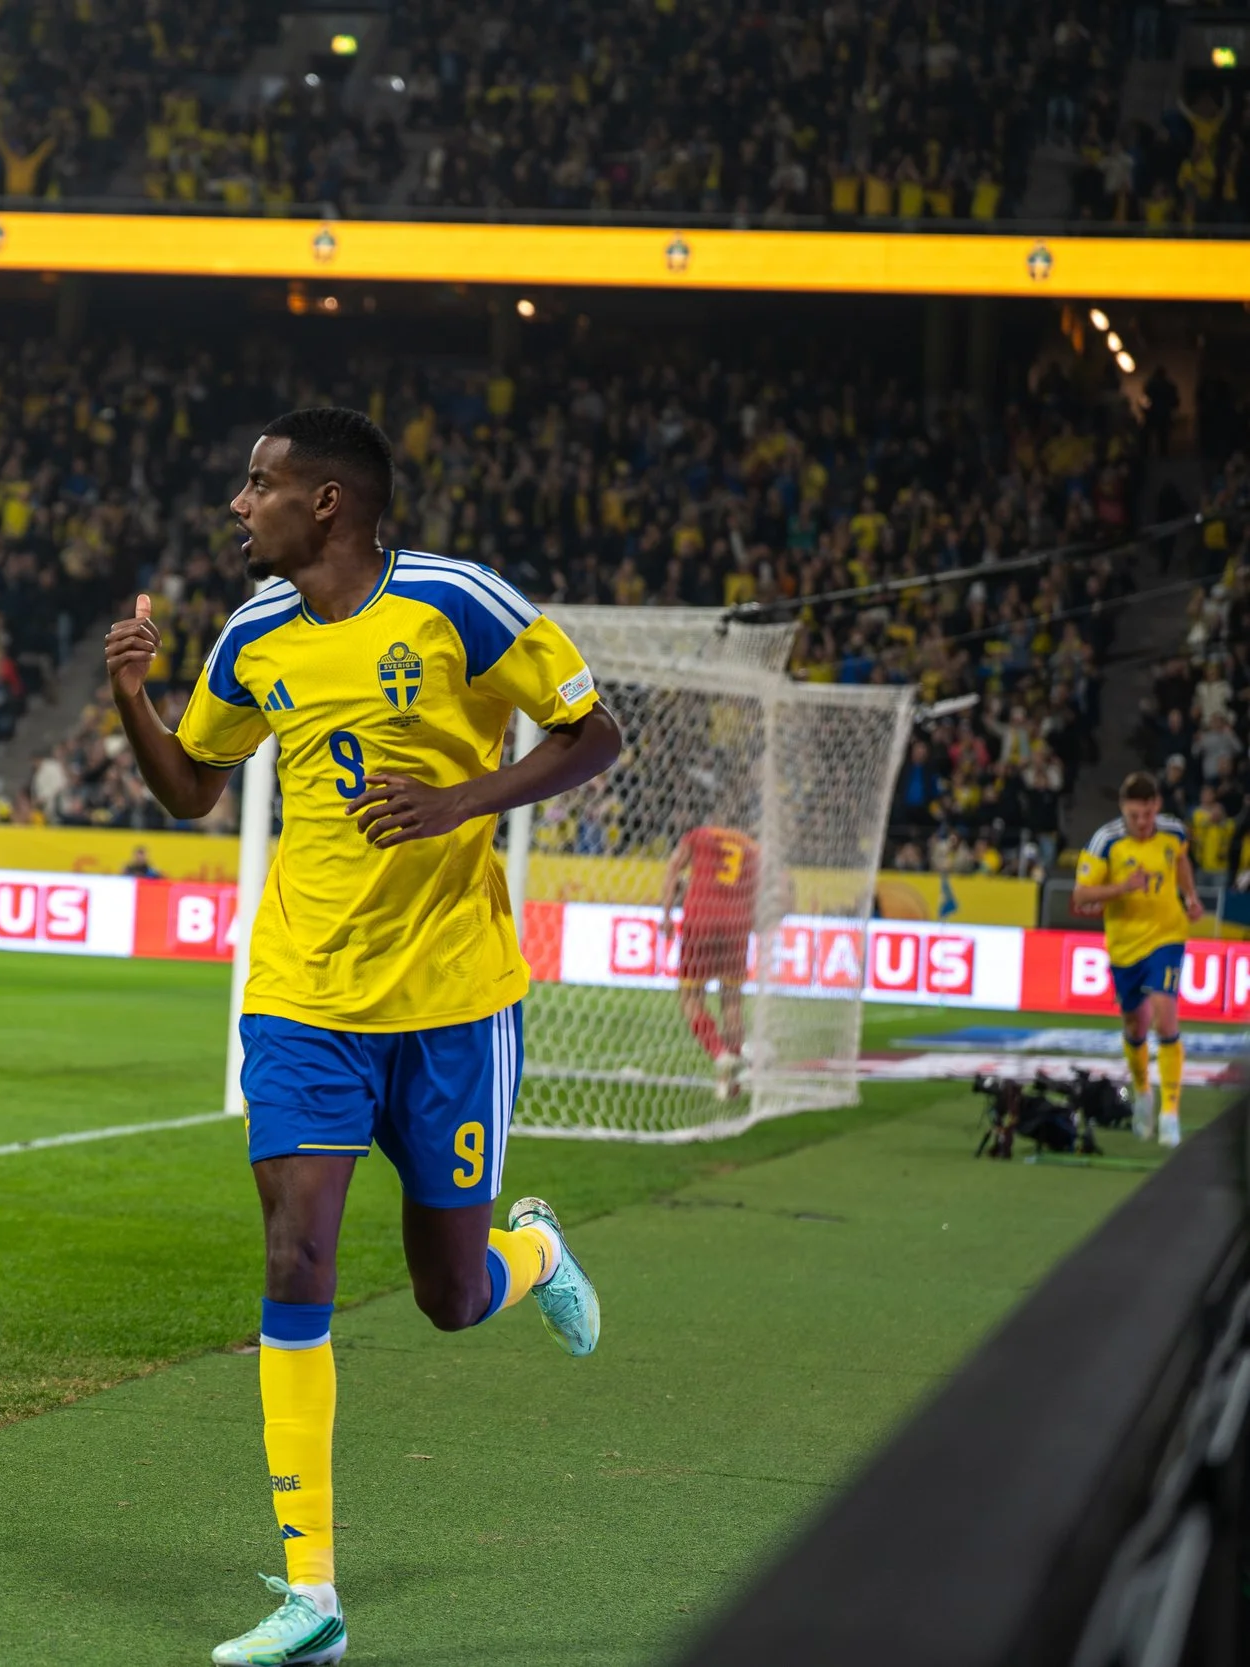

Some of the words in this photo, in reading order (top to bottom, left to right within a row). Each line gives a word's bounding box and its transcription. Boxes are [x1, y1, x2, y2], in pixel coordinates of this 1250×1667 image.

[383, 662, 416, 670] SVERIGE
[329, 730, 367, 798] 9
[718, 840, 742, 886] 3
[614, 920, 974, 989] BHAUS
[453, 1121, 485, 1189] 9
